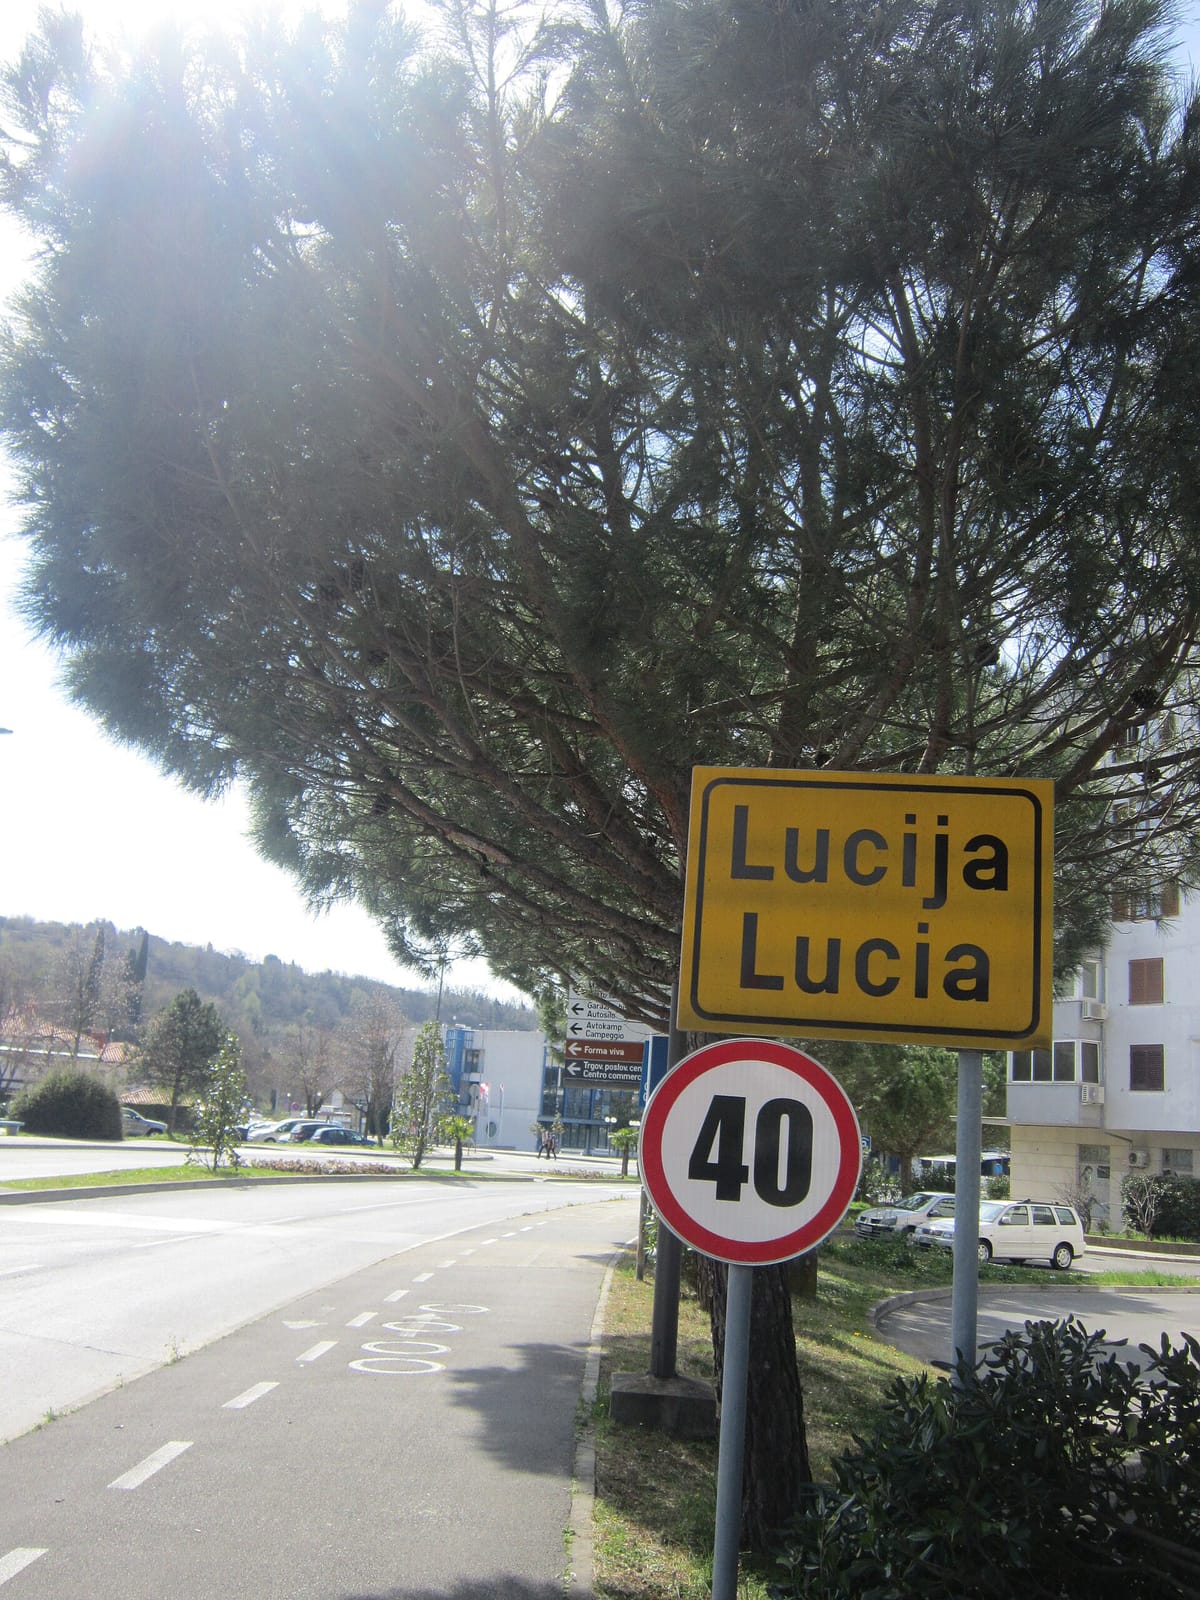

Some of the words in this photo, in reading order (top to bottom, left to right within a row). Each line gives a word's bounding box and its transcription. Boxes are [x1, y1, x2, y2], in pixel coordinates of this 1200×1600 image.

[731, 805, 1009, 909] Lucija
[740, 912, 990, 1002] Lucia
[587, 1010, 616, 1019] Autosilo
[586, 1022, 622, 1031] Avtokamp
[585, 1030, 625, 1041] Campeggio
[584, 1045, 608, 1055] Forma
[609, 1048, 625, 1056] viva
[583, 1069, 607, 1079] Centro
[688, 1095, 814, 1207] 40
